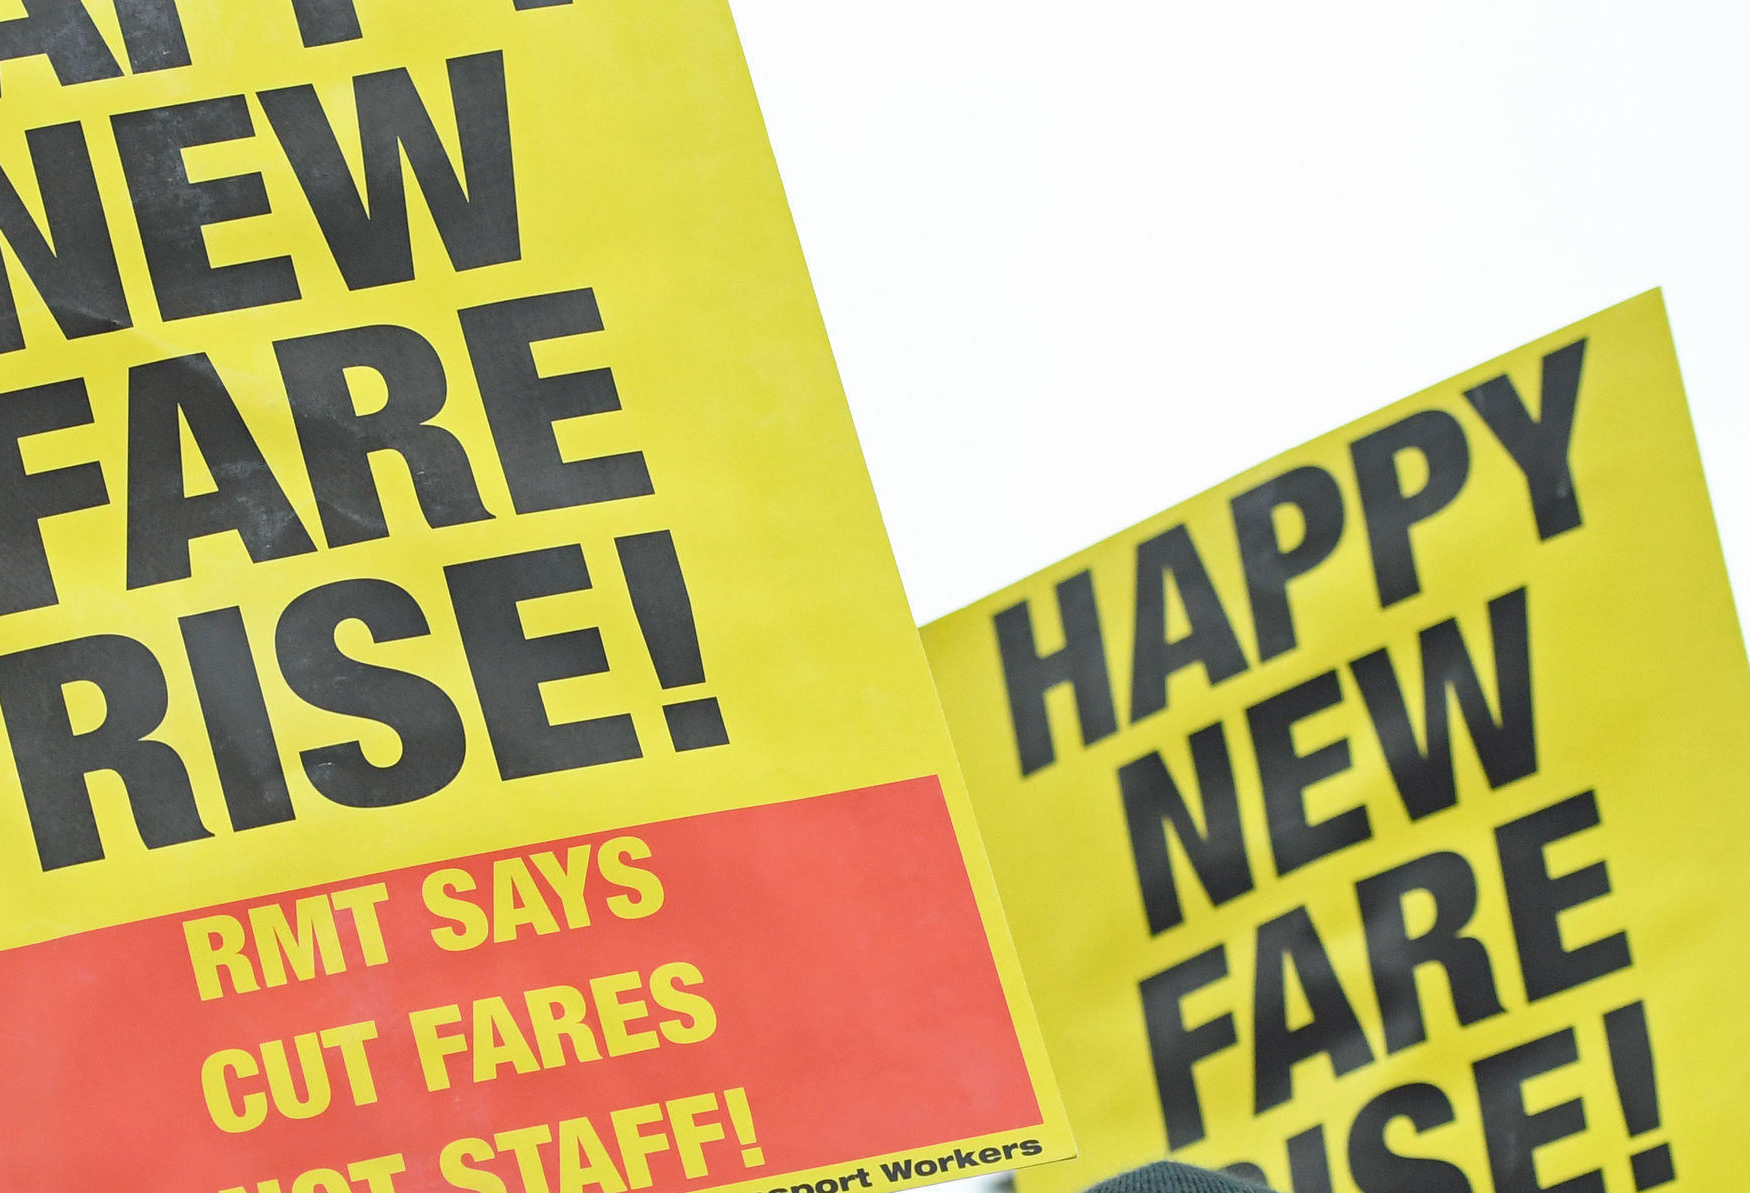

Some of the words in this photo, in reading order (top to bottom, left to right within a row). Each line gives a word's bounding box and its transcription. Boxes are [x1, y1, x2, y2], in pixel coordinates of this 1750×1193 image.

[994, 338, 1586, 776] HAPPY
[1118, 587, 1537, 936] NEW
[182, 882, 388, 1001] RMT
[422, 836, 664, 951] SAYS
[202, 1020, 378, 1133] CUT
[409, 962, 717, 1092] FARES
[1139, 790, 1632, 1151] FARE
[880, 1140, 1042, 1182] Workers
